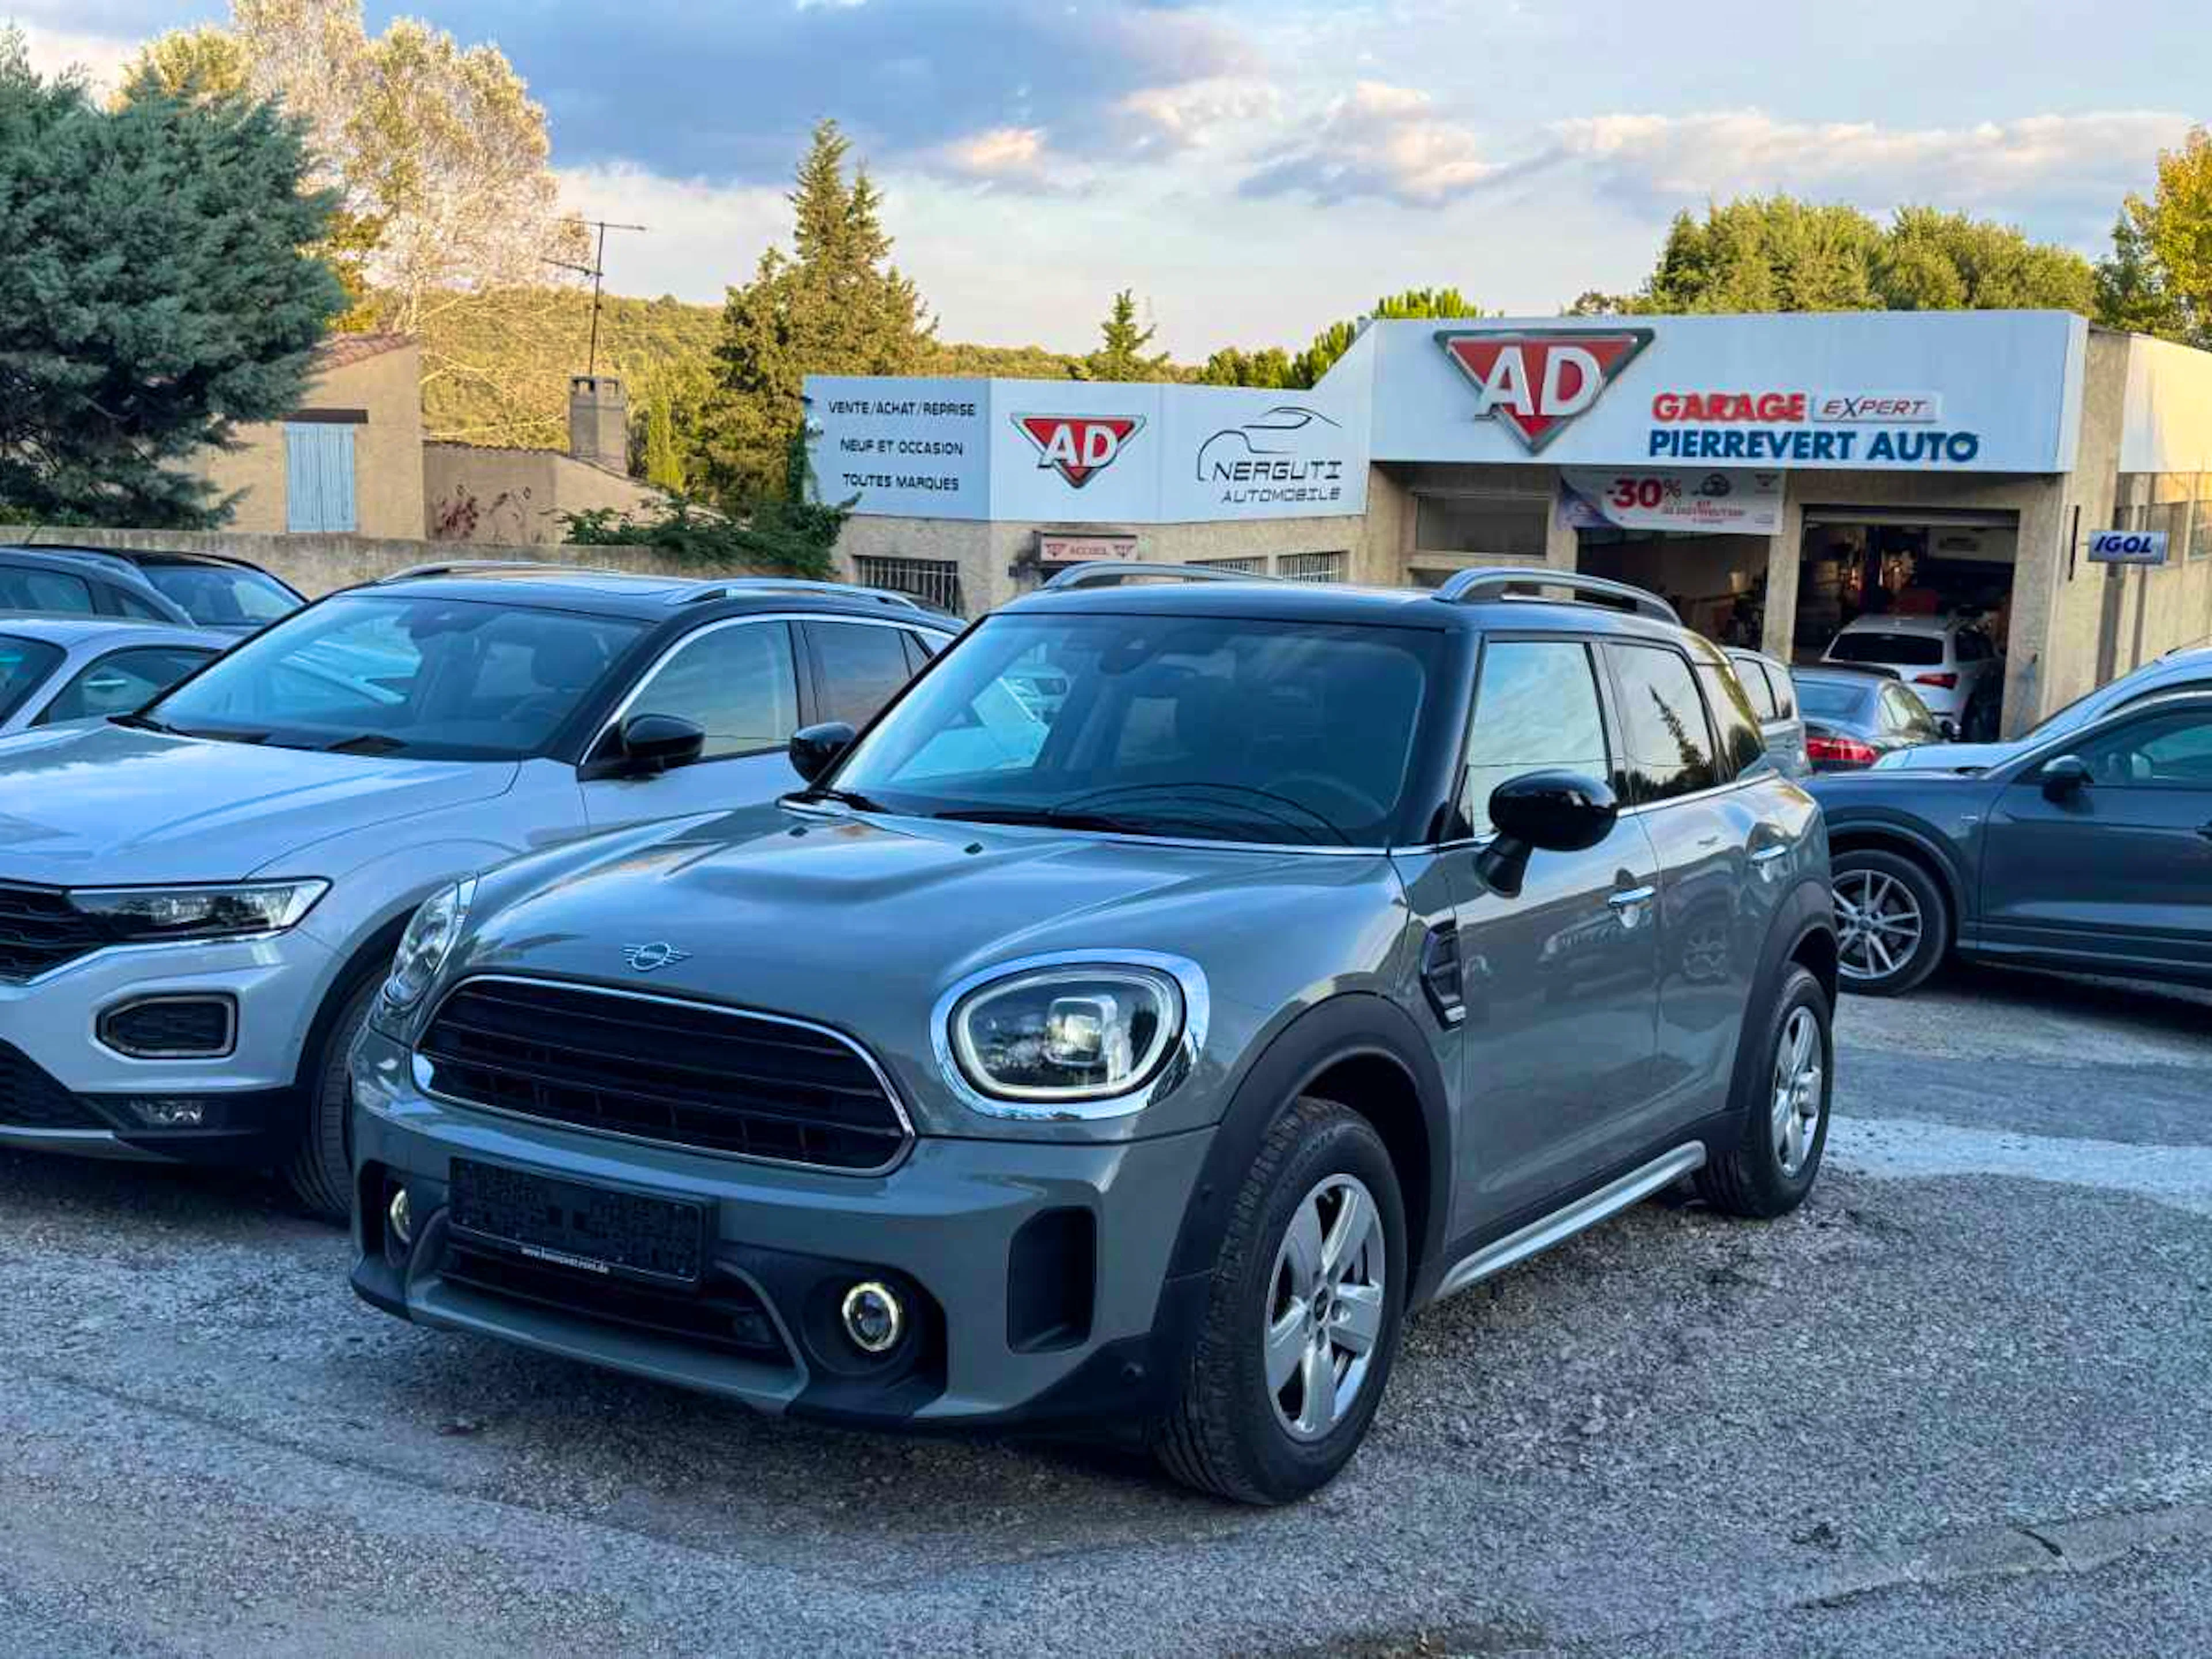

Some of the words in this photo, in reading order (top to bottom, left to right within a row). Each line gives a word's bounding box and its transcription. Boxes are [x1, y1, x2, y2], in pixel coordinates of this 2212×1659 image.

[1474, 344, 1604, 417] AD
[1651, 393, 1805, 421] GARAGE
[1823, 397, 1926, 418] EXPERT
[840, 438, 874, 452] NEUF
[878, 440, 893, 453] ET
[899, 441, 963, 455] OCCASION
[1037, 422, 1118, 468] AD
[1649, 430, 1856, 459] PIERREVERT
[1866, 431, 1978, 461] AUTO
[842, 474, 892, 487] TOUTES
[896, 475, 959, 490] MARQUES
[1222, 488, 1341, 502] AUTOMOBILE
[2094, 536, 2152, 553] IGOL
